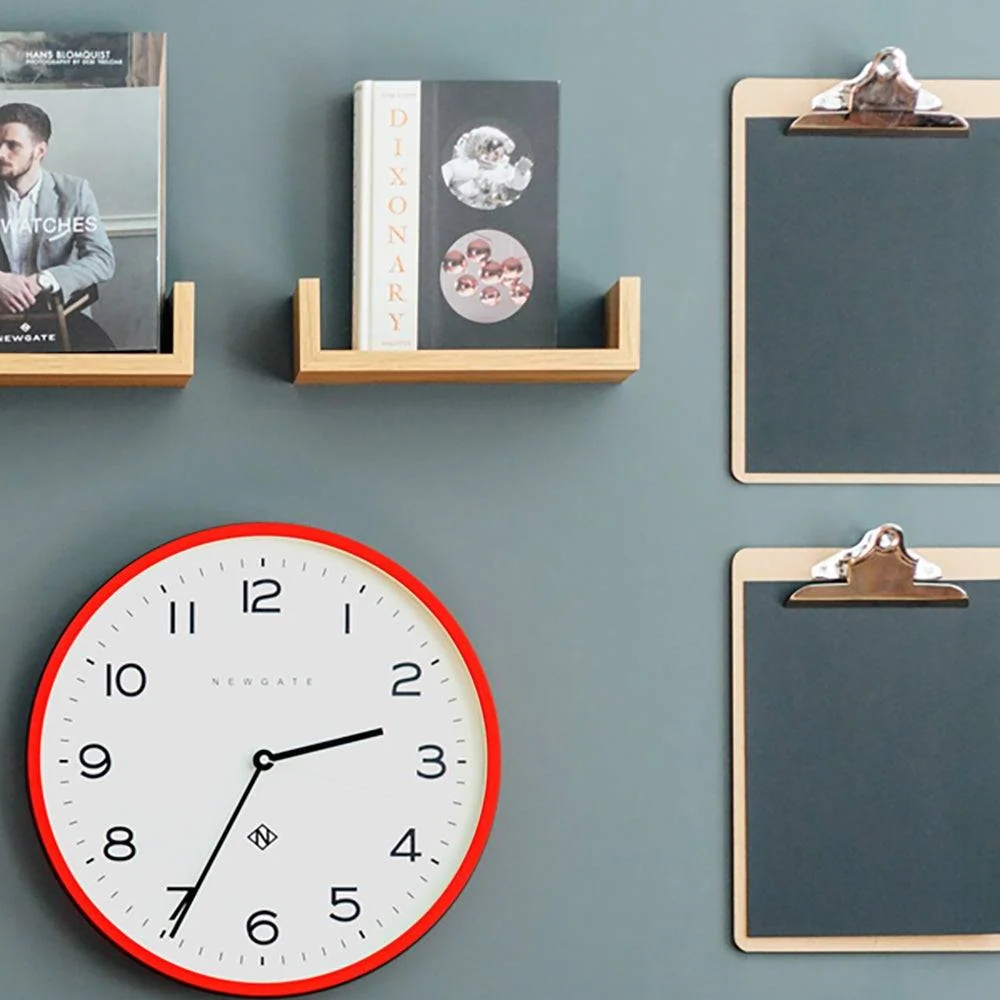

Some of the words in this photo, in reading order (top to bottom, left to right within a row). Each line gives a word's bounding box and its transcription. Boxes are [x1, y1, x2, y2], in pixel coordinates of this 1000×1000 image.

[25, 50, 54, 59] HANS
[56, 50, 110, 59] BLOMQUIST
[0, 216, 99, 234] WATCHES
[387, 109, 408, 332] DIXONARY
[242, 579, 281, 614] 12
[170, 601, 195, 634] 11
[344, 603, 350, 634] 1
[106, 663, 147, 697] 10
[211, 677, 314, 686] NEWGATE
[391, 662, 422, 696] 2
[79, 743, 112, 779] 9
[416, 745, 447, 779] 3
[103, 827, 137, 862] 8
[390, 828, 422, 862] 4
[166, 886, 197, 922] 7
[330, 887, 361, 923] 5
[246, 910, 279, 946] 6
